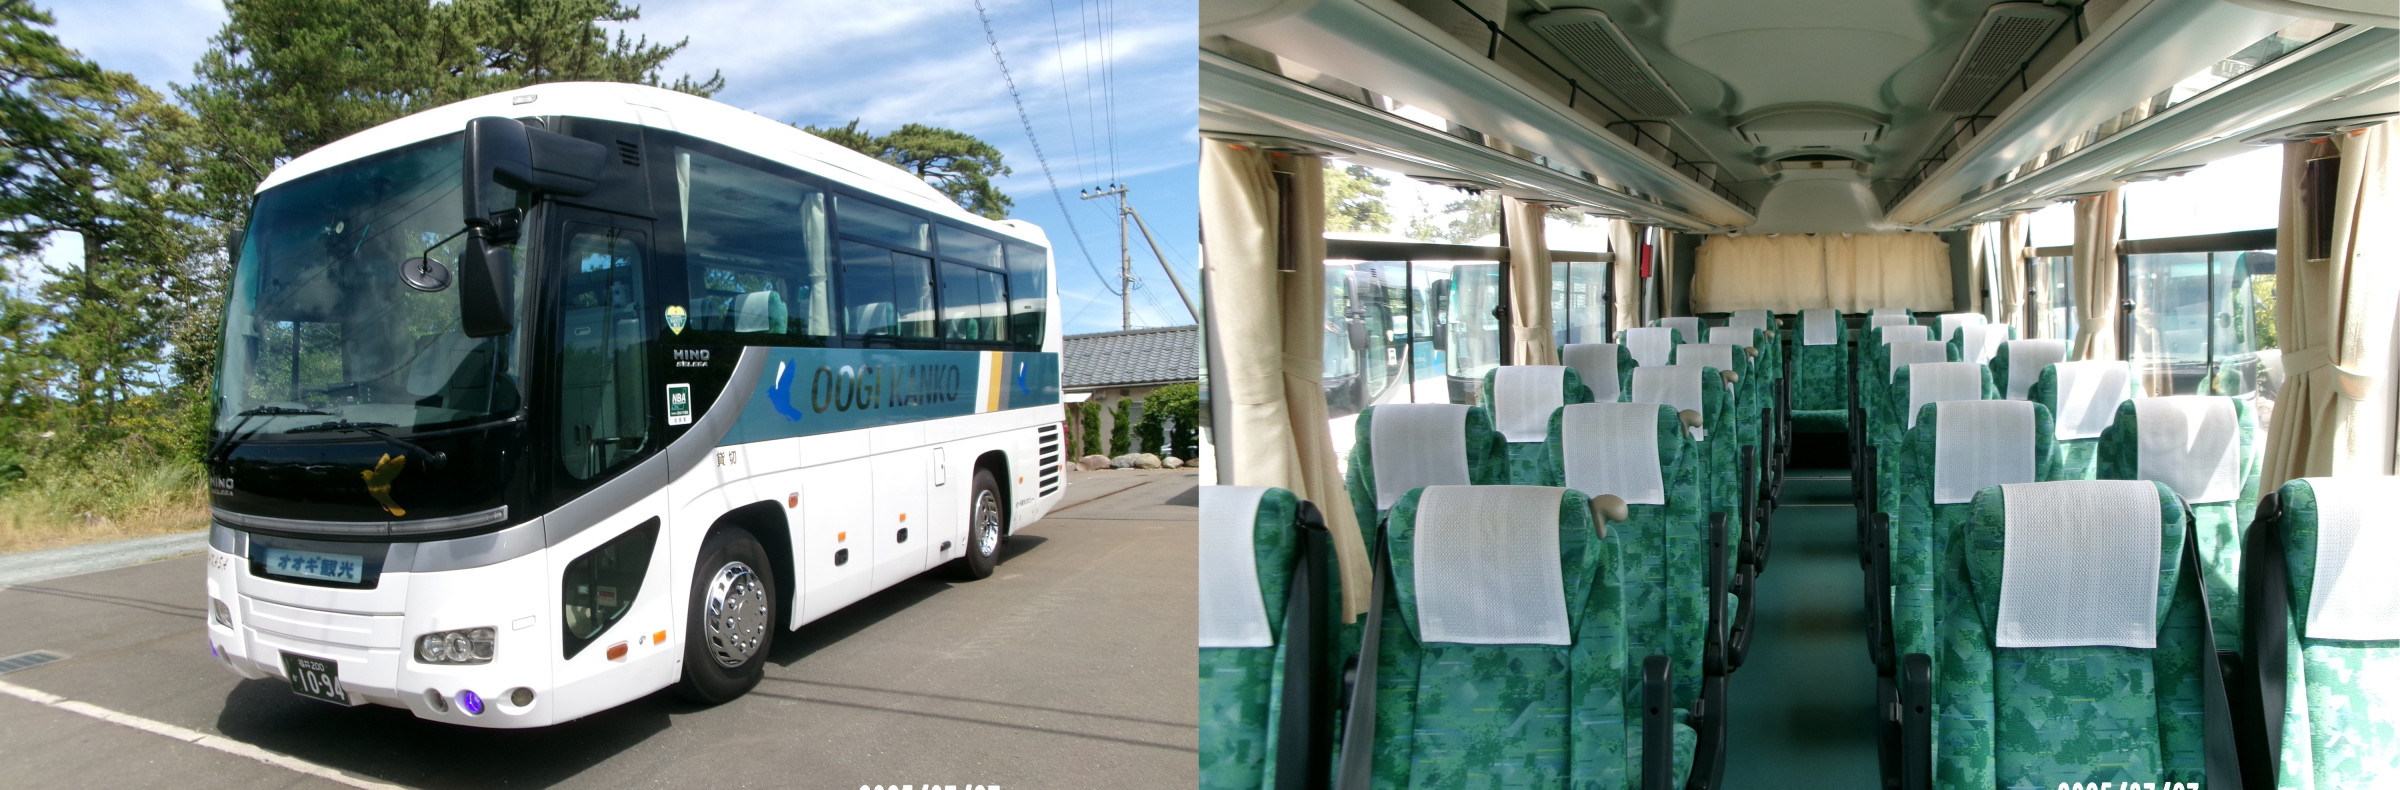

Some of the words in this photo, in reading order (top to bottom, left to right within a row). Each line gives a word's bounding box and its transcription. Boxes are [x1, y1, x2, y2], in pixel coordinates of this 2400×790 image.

[673, 349, 710, 361] HINO
[811, 364, 882, 414] OOGI
[889, 364, 960, 408] KANKO
[672, 393, 686, 404] NBA
[278, 554, 354, 579] オオギ観光
